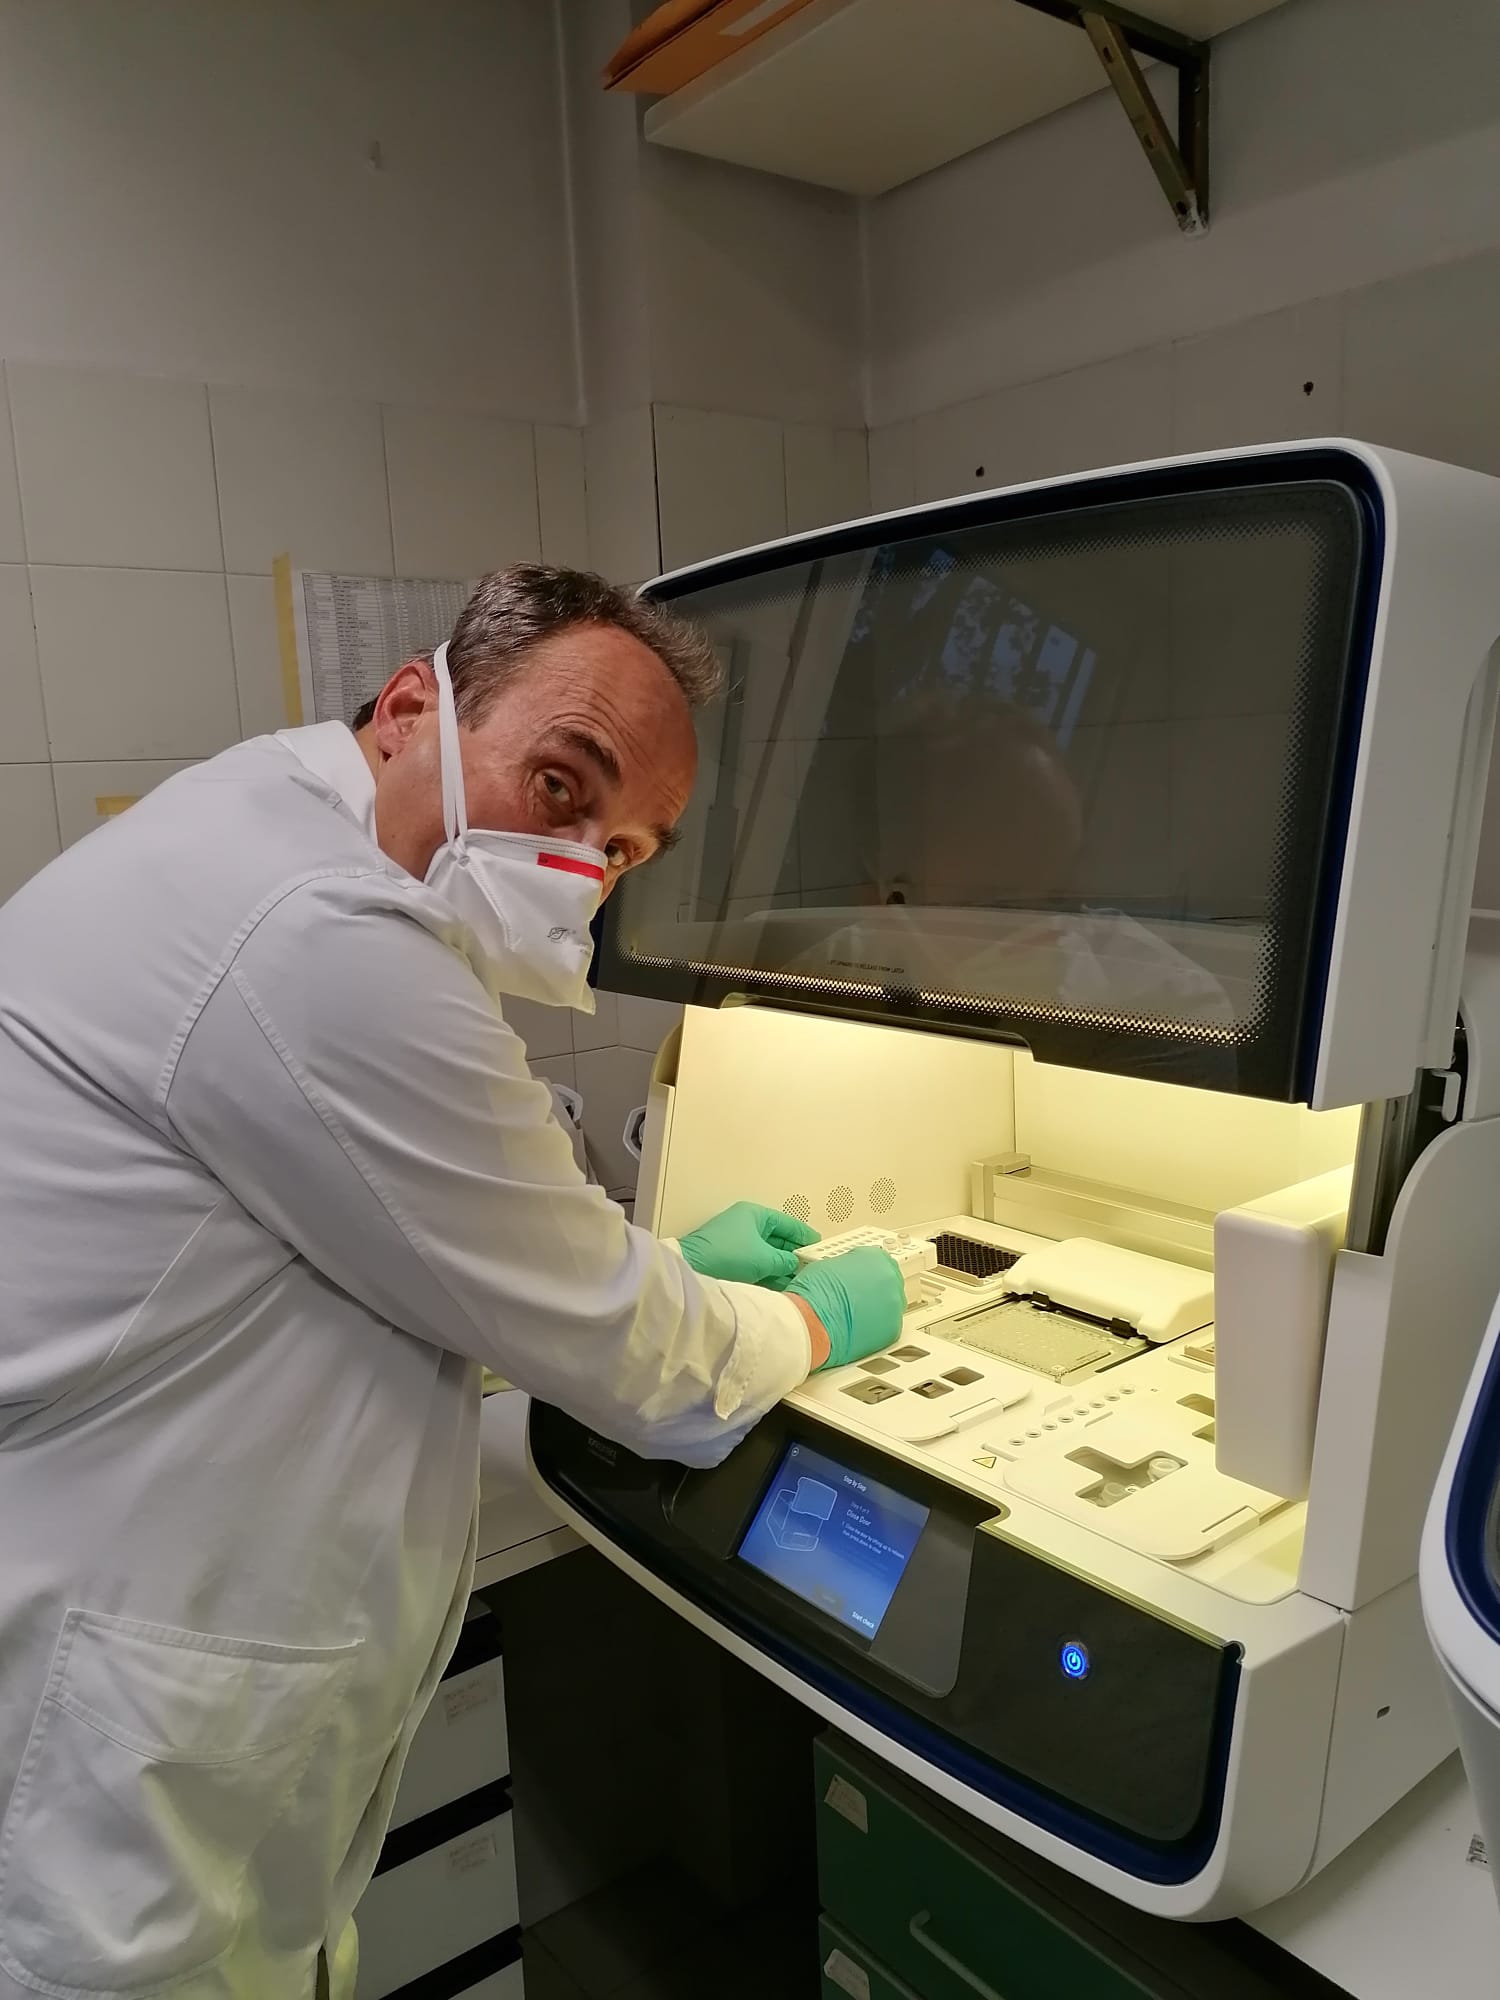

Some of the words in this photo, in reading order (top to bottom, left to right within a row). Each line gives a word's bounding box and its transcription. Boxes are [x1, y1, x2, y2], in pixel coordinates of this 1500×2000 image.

[847, 1509, 860, 1521] Close
[859, 1516, 872, 1526] Door
[852, 1611, 864, 1622] Start
